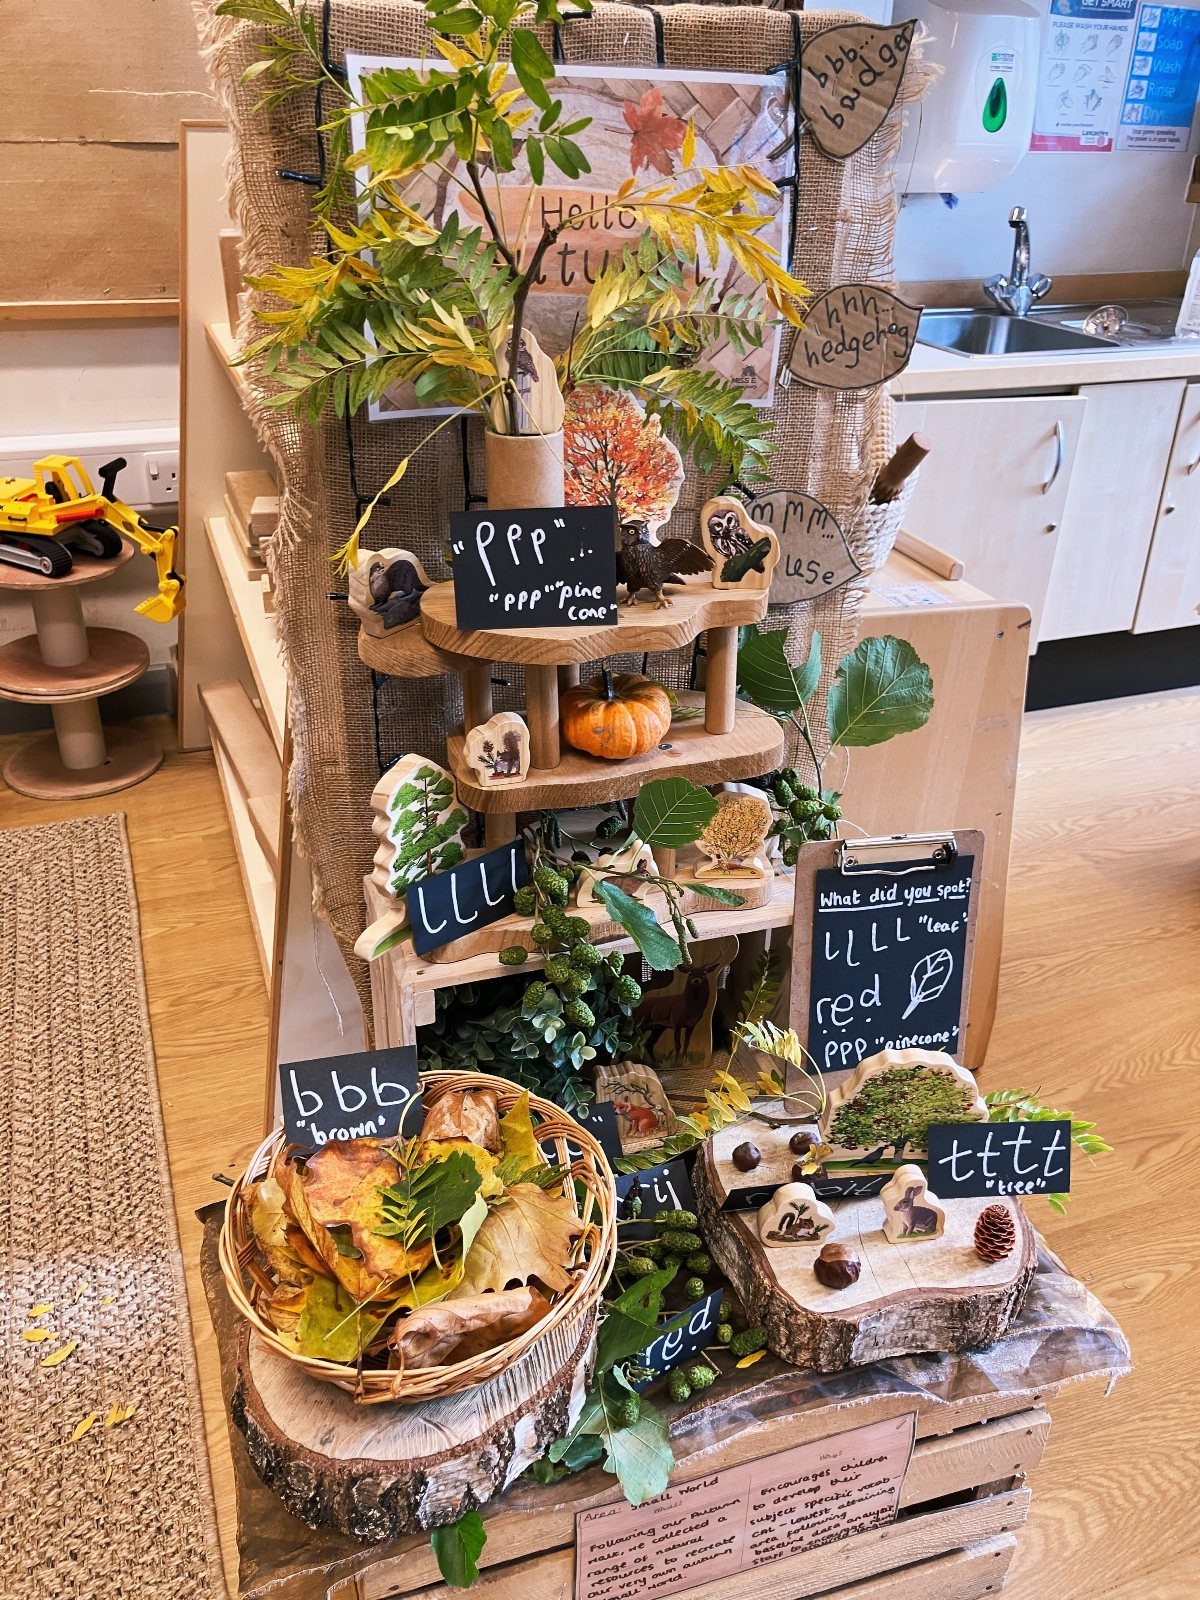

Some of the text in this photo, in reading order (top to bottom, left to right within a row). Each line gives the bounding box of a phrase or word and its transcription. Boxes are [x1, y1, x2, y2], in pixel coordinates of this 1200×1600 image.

[1101, 0, 1133, 8] SMART
[1157, 36, 1183, 53] Soap
[1153, 59, 1181, 73] Wash
[1148, 83, 1176, 97] Rinse
[541, 195, 637, 230] Hello
[804, 317, 909, 368] hedgehog
[820, 877, 972, 907] What did you spot?
[761, 1455, 887, 1496] Encourages children
[773, 1486, 821, 1505] develop
[830, 1472, 862, 1486] their
[584, 1509, 622, 1522] Area:
[750, 1507, 796, 1525] subject
[804, 1490, 852, 1509] specific
[858, 1477, 890, 1493] vocab
[590, 1498, 741, 1552] Following our Autumn
[629, 1542, 645, 1552] we
[652, 1520, 709, 1544] collected
[750, 1511, 847, 1549] area following
[751, 1527, 775, 1538] CAL
[754, 1535, 804, 1556] baseline
[812, 1522, 840, 1537] data
[587, 1536, 704, 1578] range of natural
[588, 1548, 732, 1599] our very own autumn
[591, 1535, 736, 1587] resources to recreate
